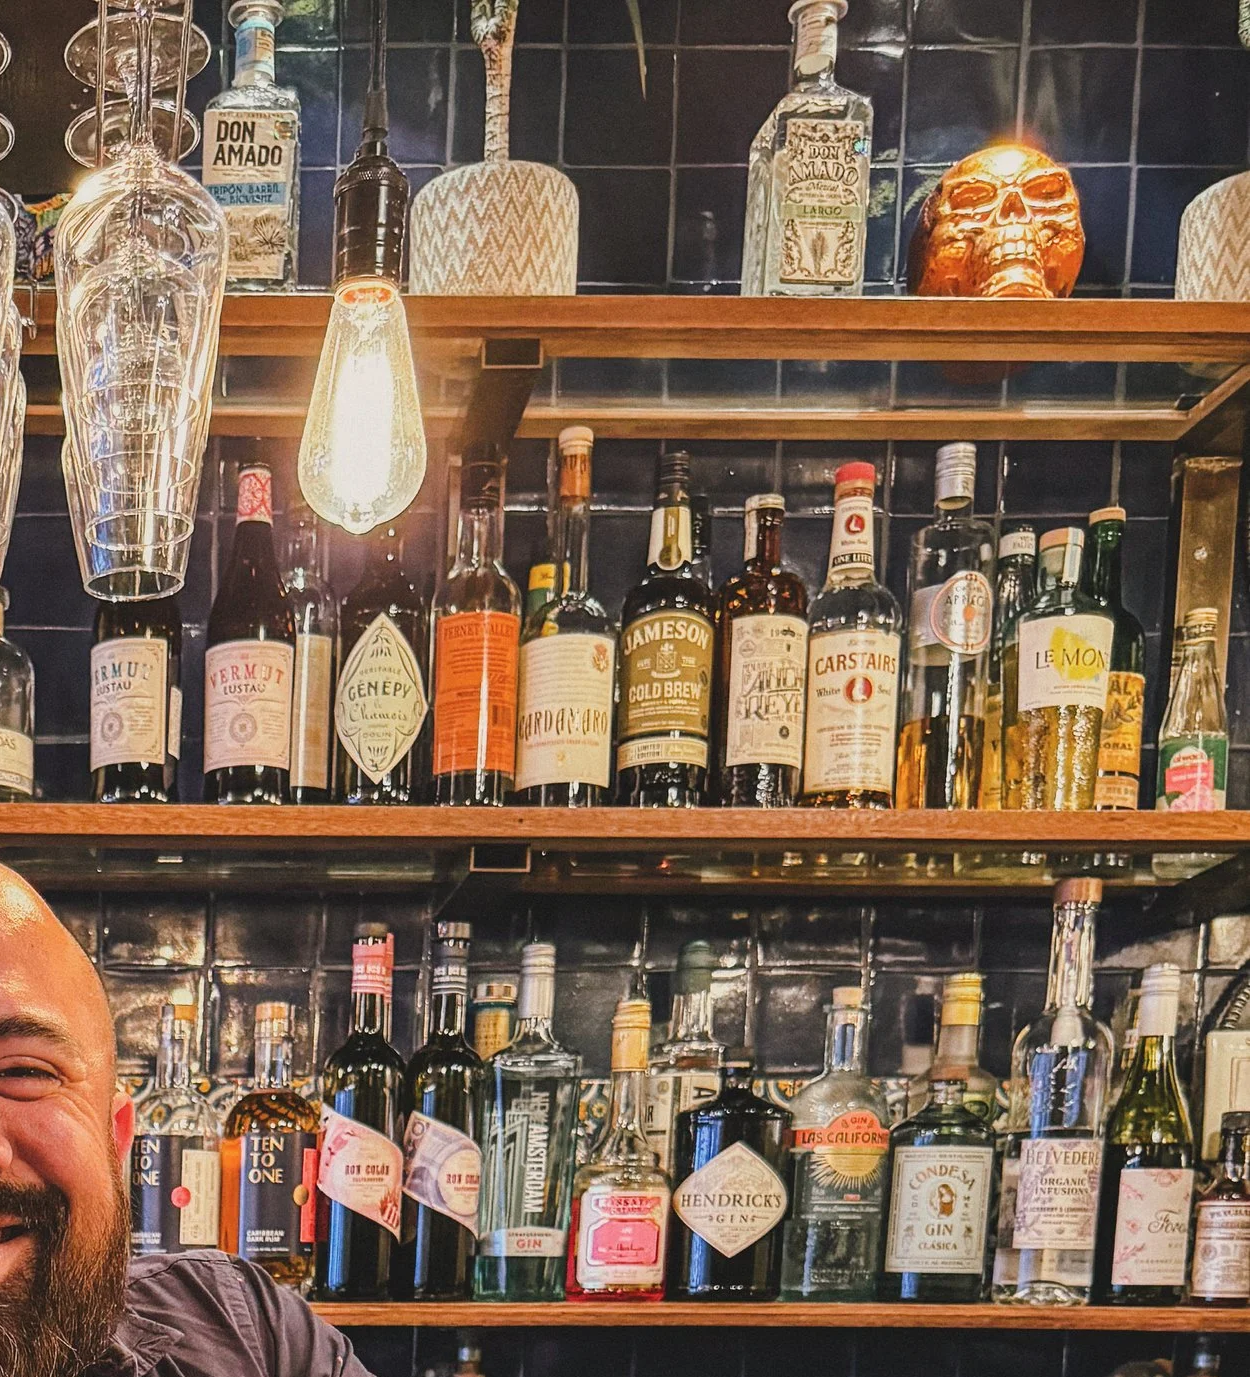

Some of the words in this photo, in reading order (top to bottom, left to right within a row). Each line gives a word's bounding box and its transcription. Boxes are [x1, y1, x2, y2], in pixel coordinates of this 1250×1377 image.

[216, 120, 256, 143] DON
[213, 144, 282, 167] AMADO
[809, 145, 840, 160] DON
[789, 161, 859, 186] AMADO
[806, 182, 839, 192] Mezcal
[803, 205, 842, 216] LARGO
[833, 554, 850, 564] ONE
[624, 620, 710, 656] JAMESON
[815, 651, 897, 676] CARSTAIRS
[94, 661, 153, 686] ERMUT
[209, 663, 285, 689] VERMUT
[223, 683, 267, 696] LUSTAU
[628, 682, 662, 704] COLD
[664, 680, 702, 700] BREW
[816, 688, 841, 698] White
[637, 743, 661, 753] LIMITED
[850, 1116, 868, 1124] GIN
[132, 1137, 160, 1154] TEN
[250, 1136, 285, 1152] TEN
[801, 1132, 823, 1144] LAS
[132, 1155, 152, 1170] TO
[250, 1152, 275, 1166] TO
[524, 1123, 549, 1213] AMSTERDAM
[132, 1170, 161, 1186] ONE
[248, 1168, 284, 1185] ONE
[908, 1164, 976, 1191] CONDESA
[1040, 1178, 1087, 1186] ORGANIC
[1035, 1187, 1089, 1196] INFUSIONS
[680, 1192, 782, 1209] HENDRICK'S
[715, 1214, 749, 1224] GIN
[925, 1223, 954, 1237] GIN
[516, 1239, 543, 1249] GIN
[917, 1240, 958, 1251] CLÁSICA
